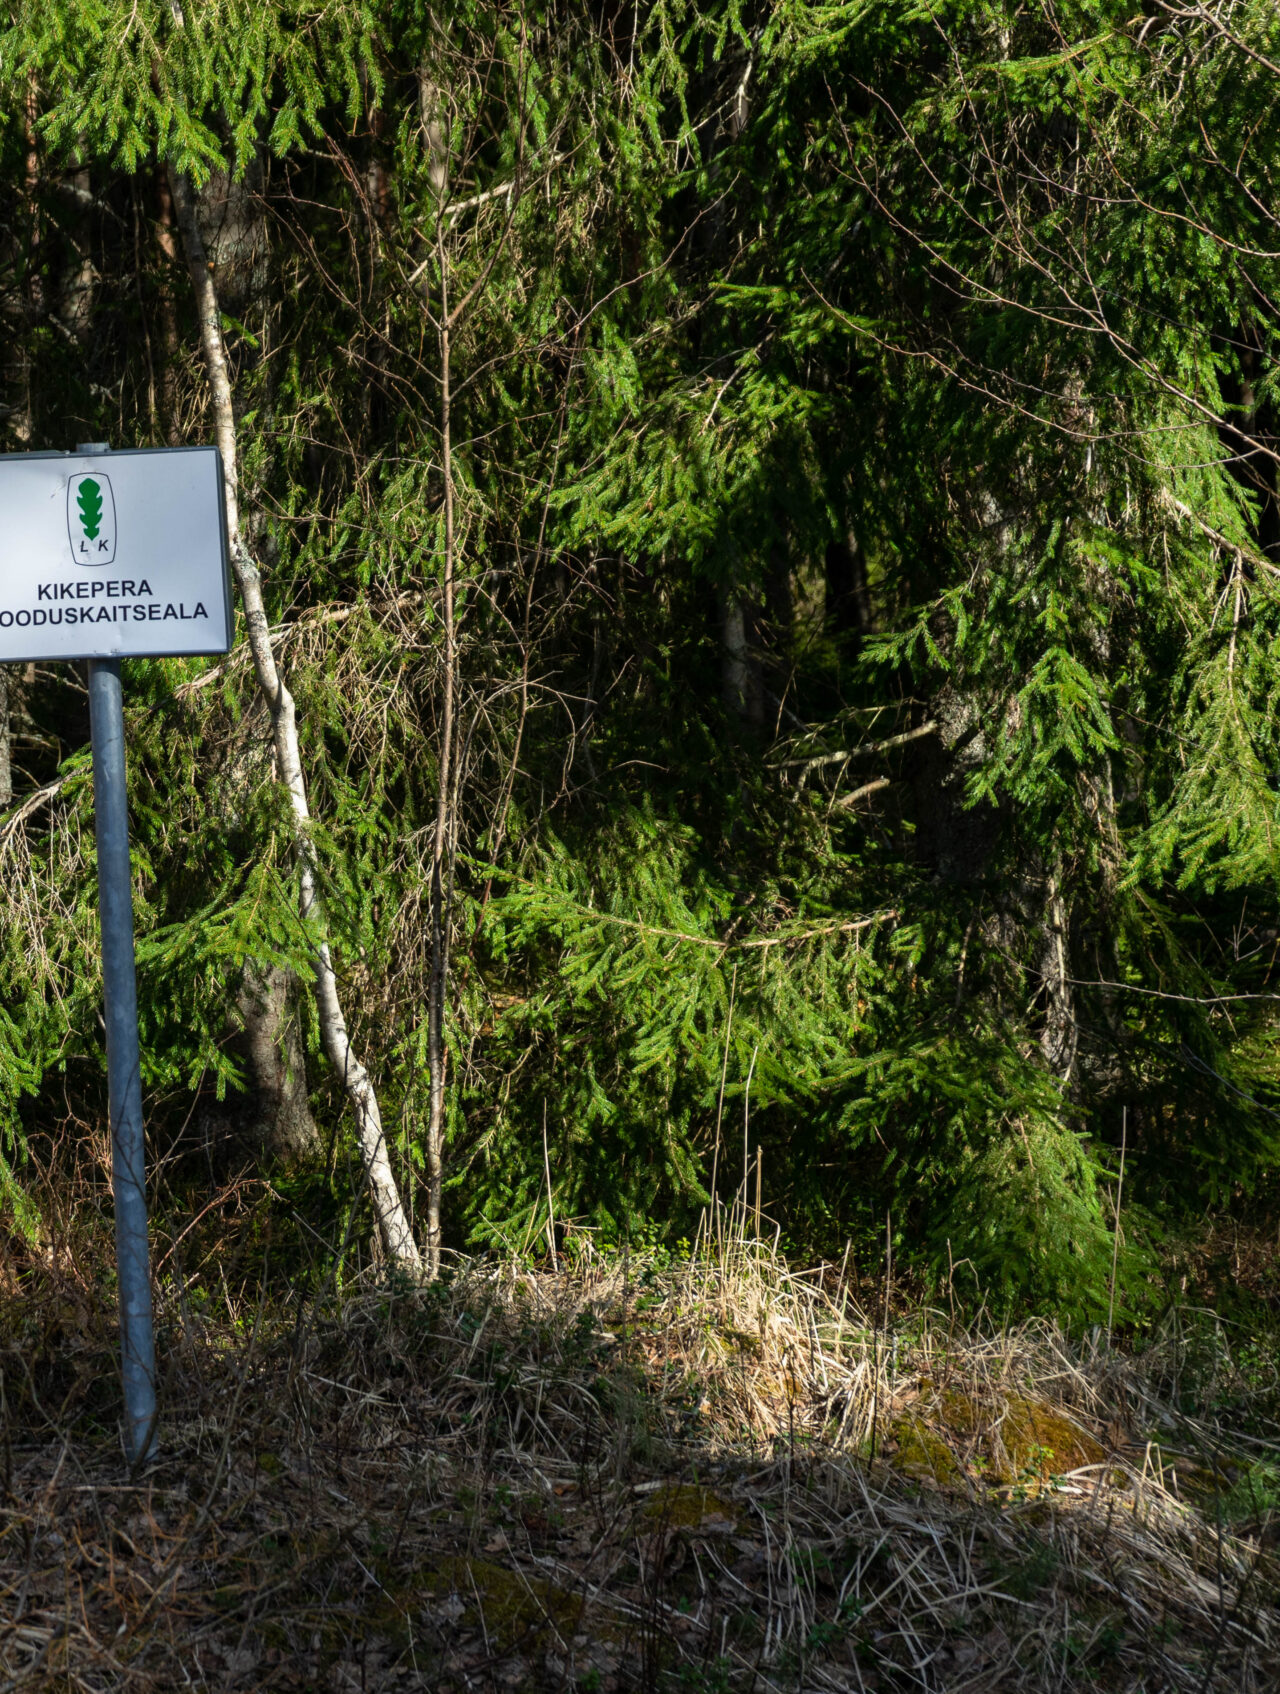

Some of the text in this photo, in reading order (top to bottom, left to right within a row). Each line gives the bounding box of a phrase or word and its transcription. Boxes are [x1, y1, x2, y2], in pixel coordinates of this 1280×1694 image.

[80, 539, 109, 553] L K
[37, 579, 153, 601] KIKEPERA
